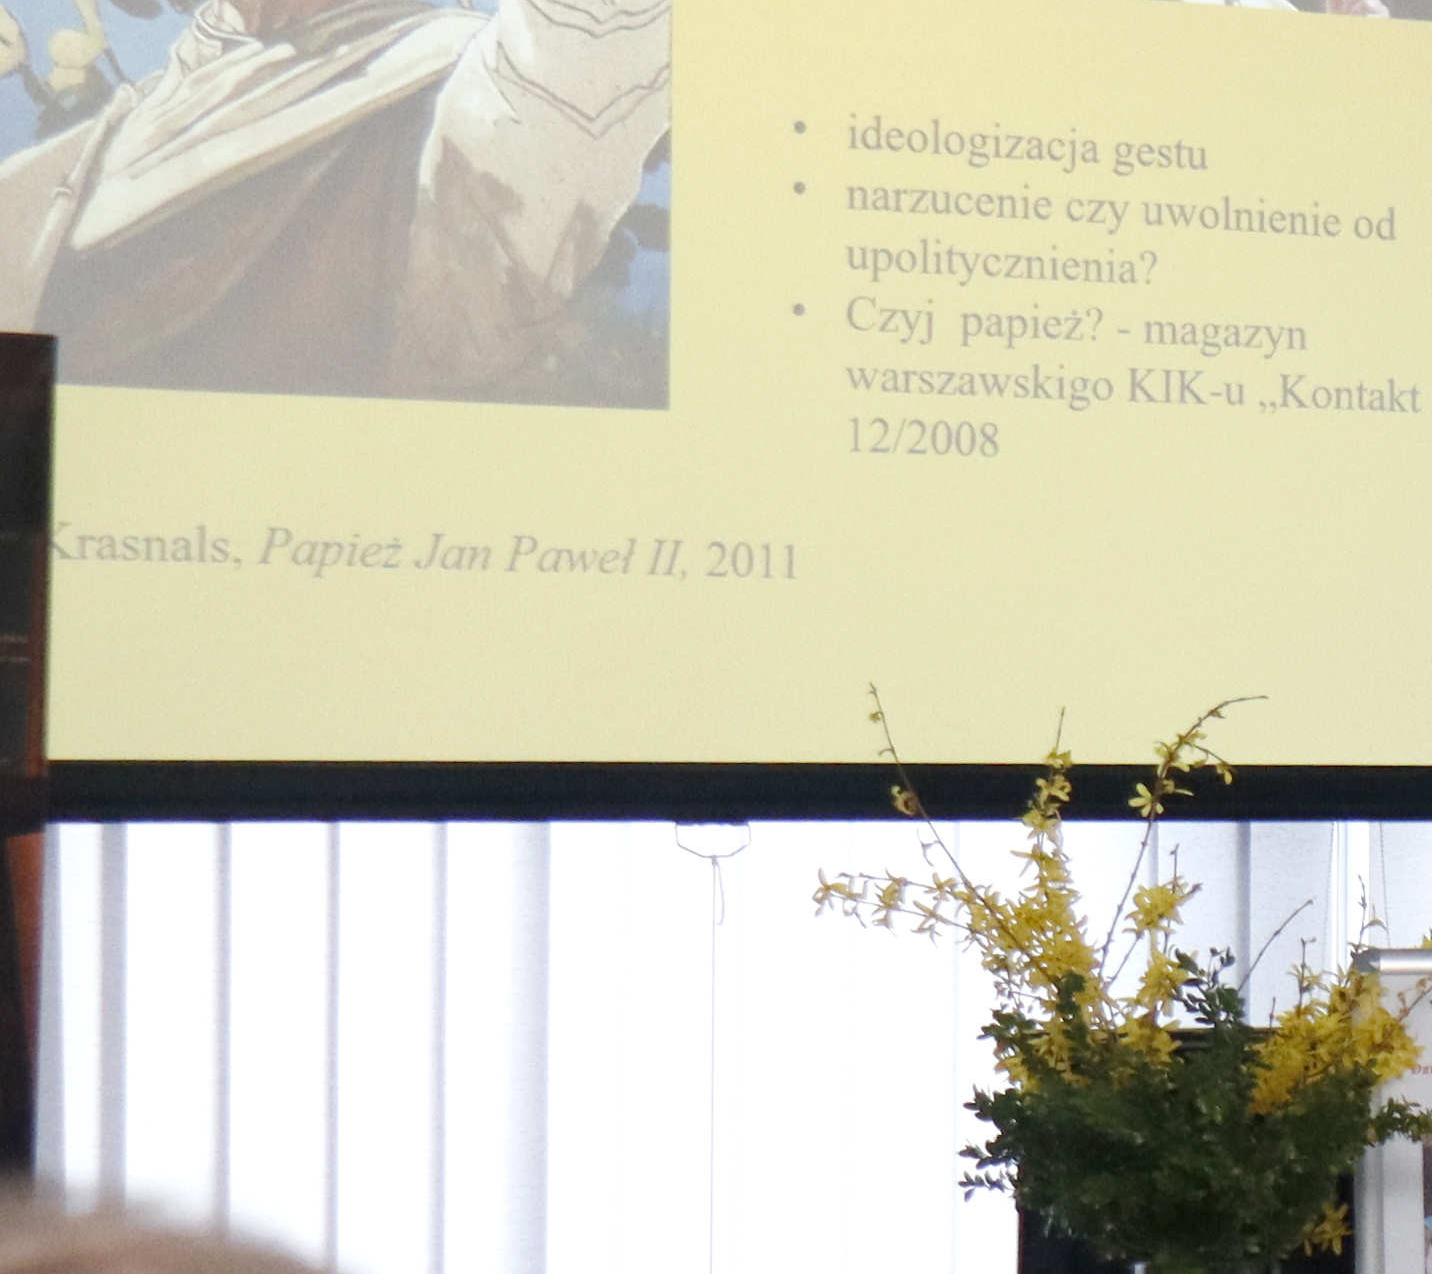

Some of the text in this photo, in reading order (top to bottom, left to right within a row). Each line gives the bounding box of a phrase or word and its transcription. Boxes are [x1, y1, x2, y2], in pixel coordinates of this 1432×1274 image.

[847, 113, 1209, 176] ideologizacja gestu
[846, 182, 1397, 242] narzucenie czy uwolnienie od
[846, 238, 1158, 287] upolitycznienia?
[846, 296, 935, 345] Czyj
[959, 305, 1104, 349] papież?
[1143, 316, 1308, 360] magazyn
[845, 363, 1421, 415] warszawskigo KIK-u „Kontakt
[848, 417, 1000, 459] 12/2008
[256, 526, 404, 580] Papież
[413, 531, 492, 572] Jan
[503, 535, 639, 578] Paweł
[645, 538, 691, 582] II,
[705, 541, 799, 581] 2011
